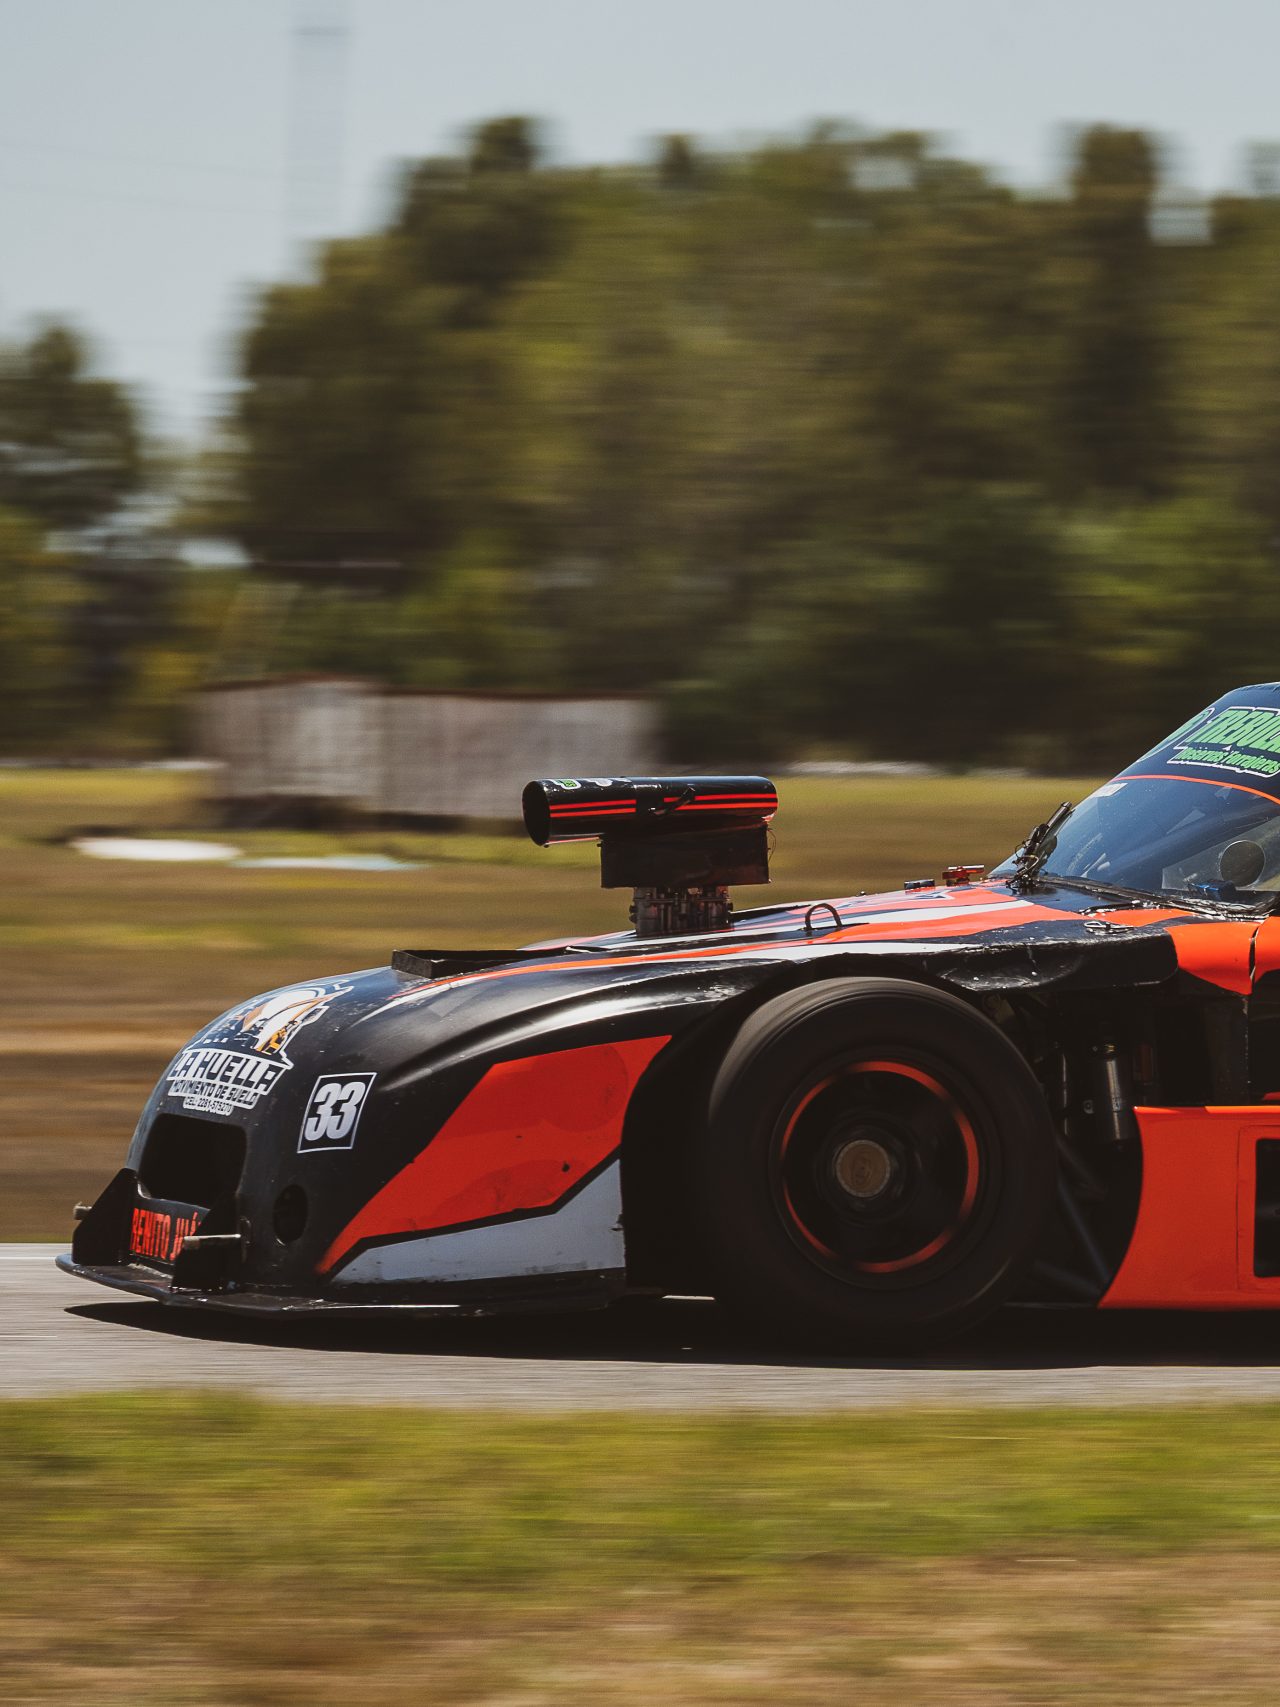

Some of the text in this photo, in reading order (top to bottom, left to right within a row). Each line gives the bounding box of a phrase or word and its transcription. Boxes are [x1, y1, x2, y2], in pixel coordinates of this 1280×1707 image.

[192, 1051, 285, 1093] HUELLA
[213, 1083, 229, 1100] DE
[226, 1086, 258, 1106] SUELO
[304, 1081, 366, 1142] 33
